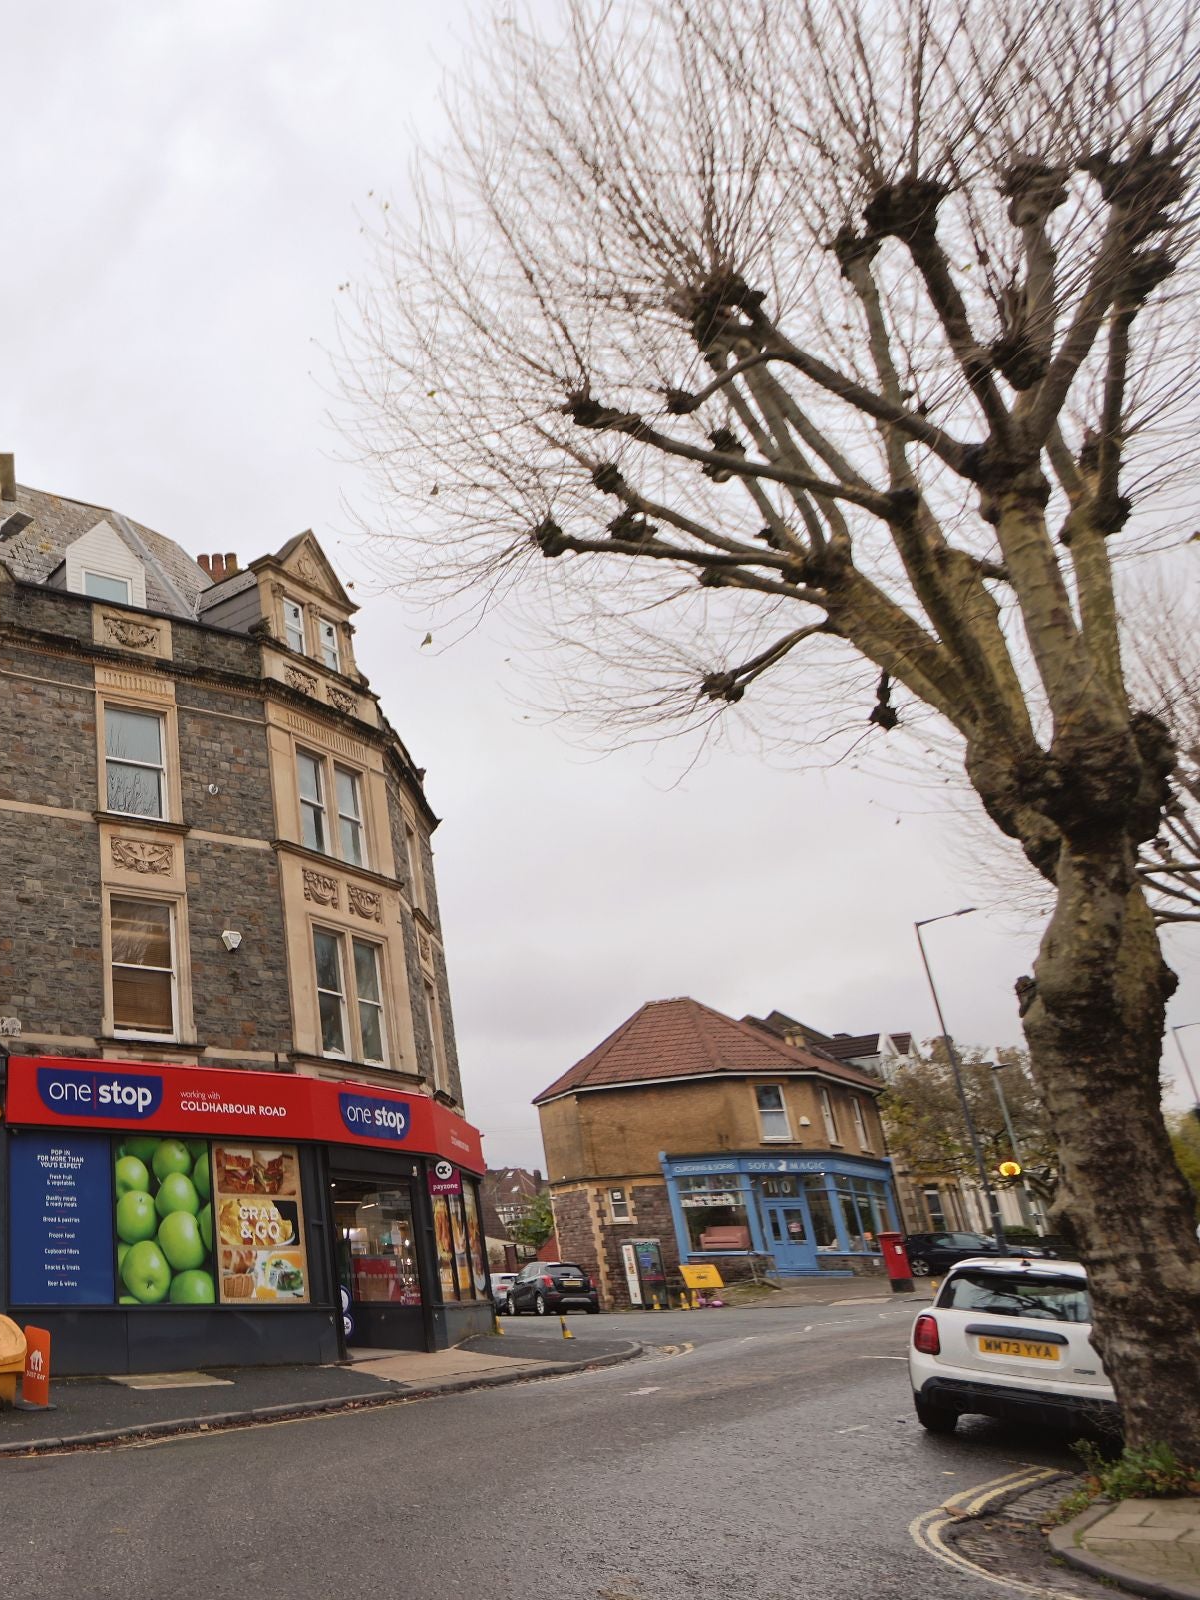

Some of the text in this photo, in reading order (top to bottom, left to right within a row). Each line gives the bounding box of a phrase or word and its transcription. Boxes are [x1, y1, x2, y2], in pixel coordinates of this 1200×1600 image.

[49, 1080, 152, 1113] one stop
[180, 1091, 221, 1101] working with
[180, 1100, 287, 1117] COLDHARBOUR ROAD
[346, 1105, 405, 1135] one stop
[748, 1162, 825, 1170] SOFA MAGIC
[432, 1182, 459, 1192] payzone
[239, 1206, 279, 1220] GRAB
[240, 1221, 280, 1240] & GO
[1023, 1343, 1052, 1358] YYA
